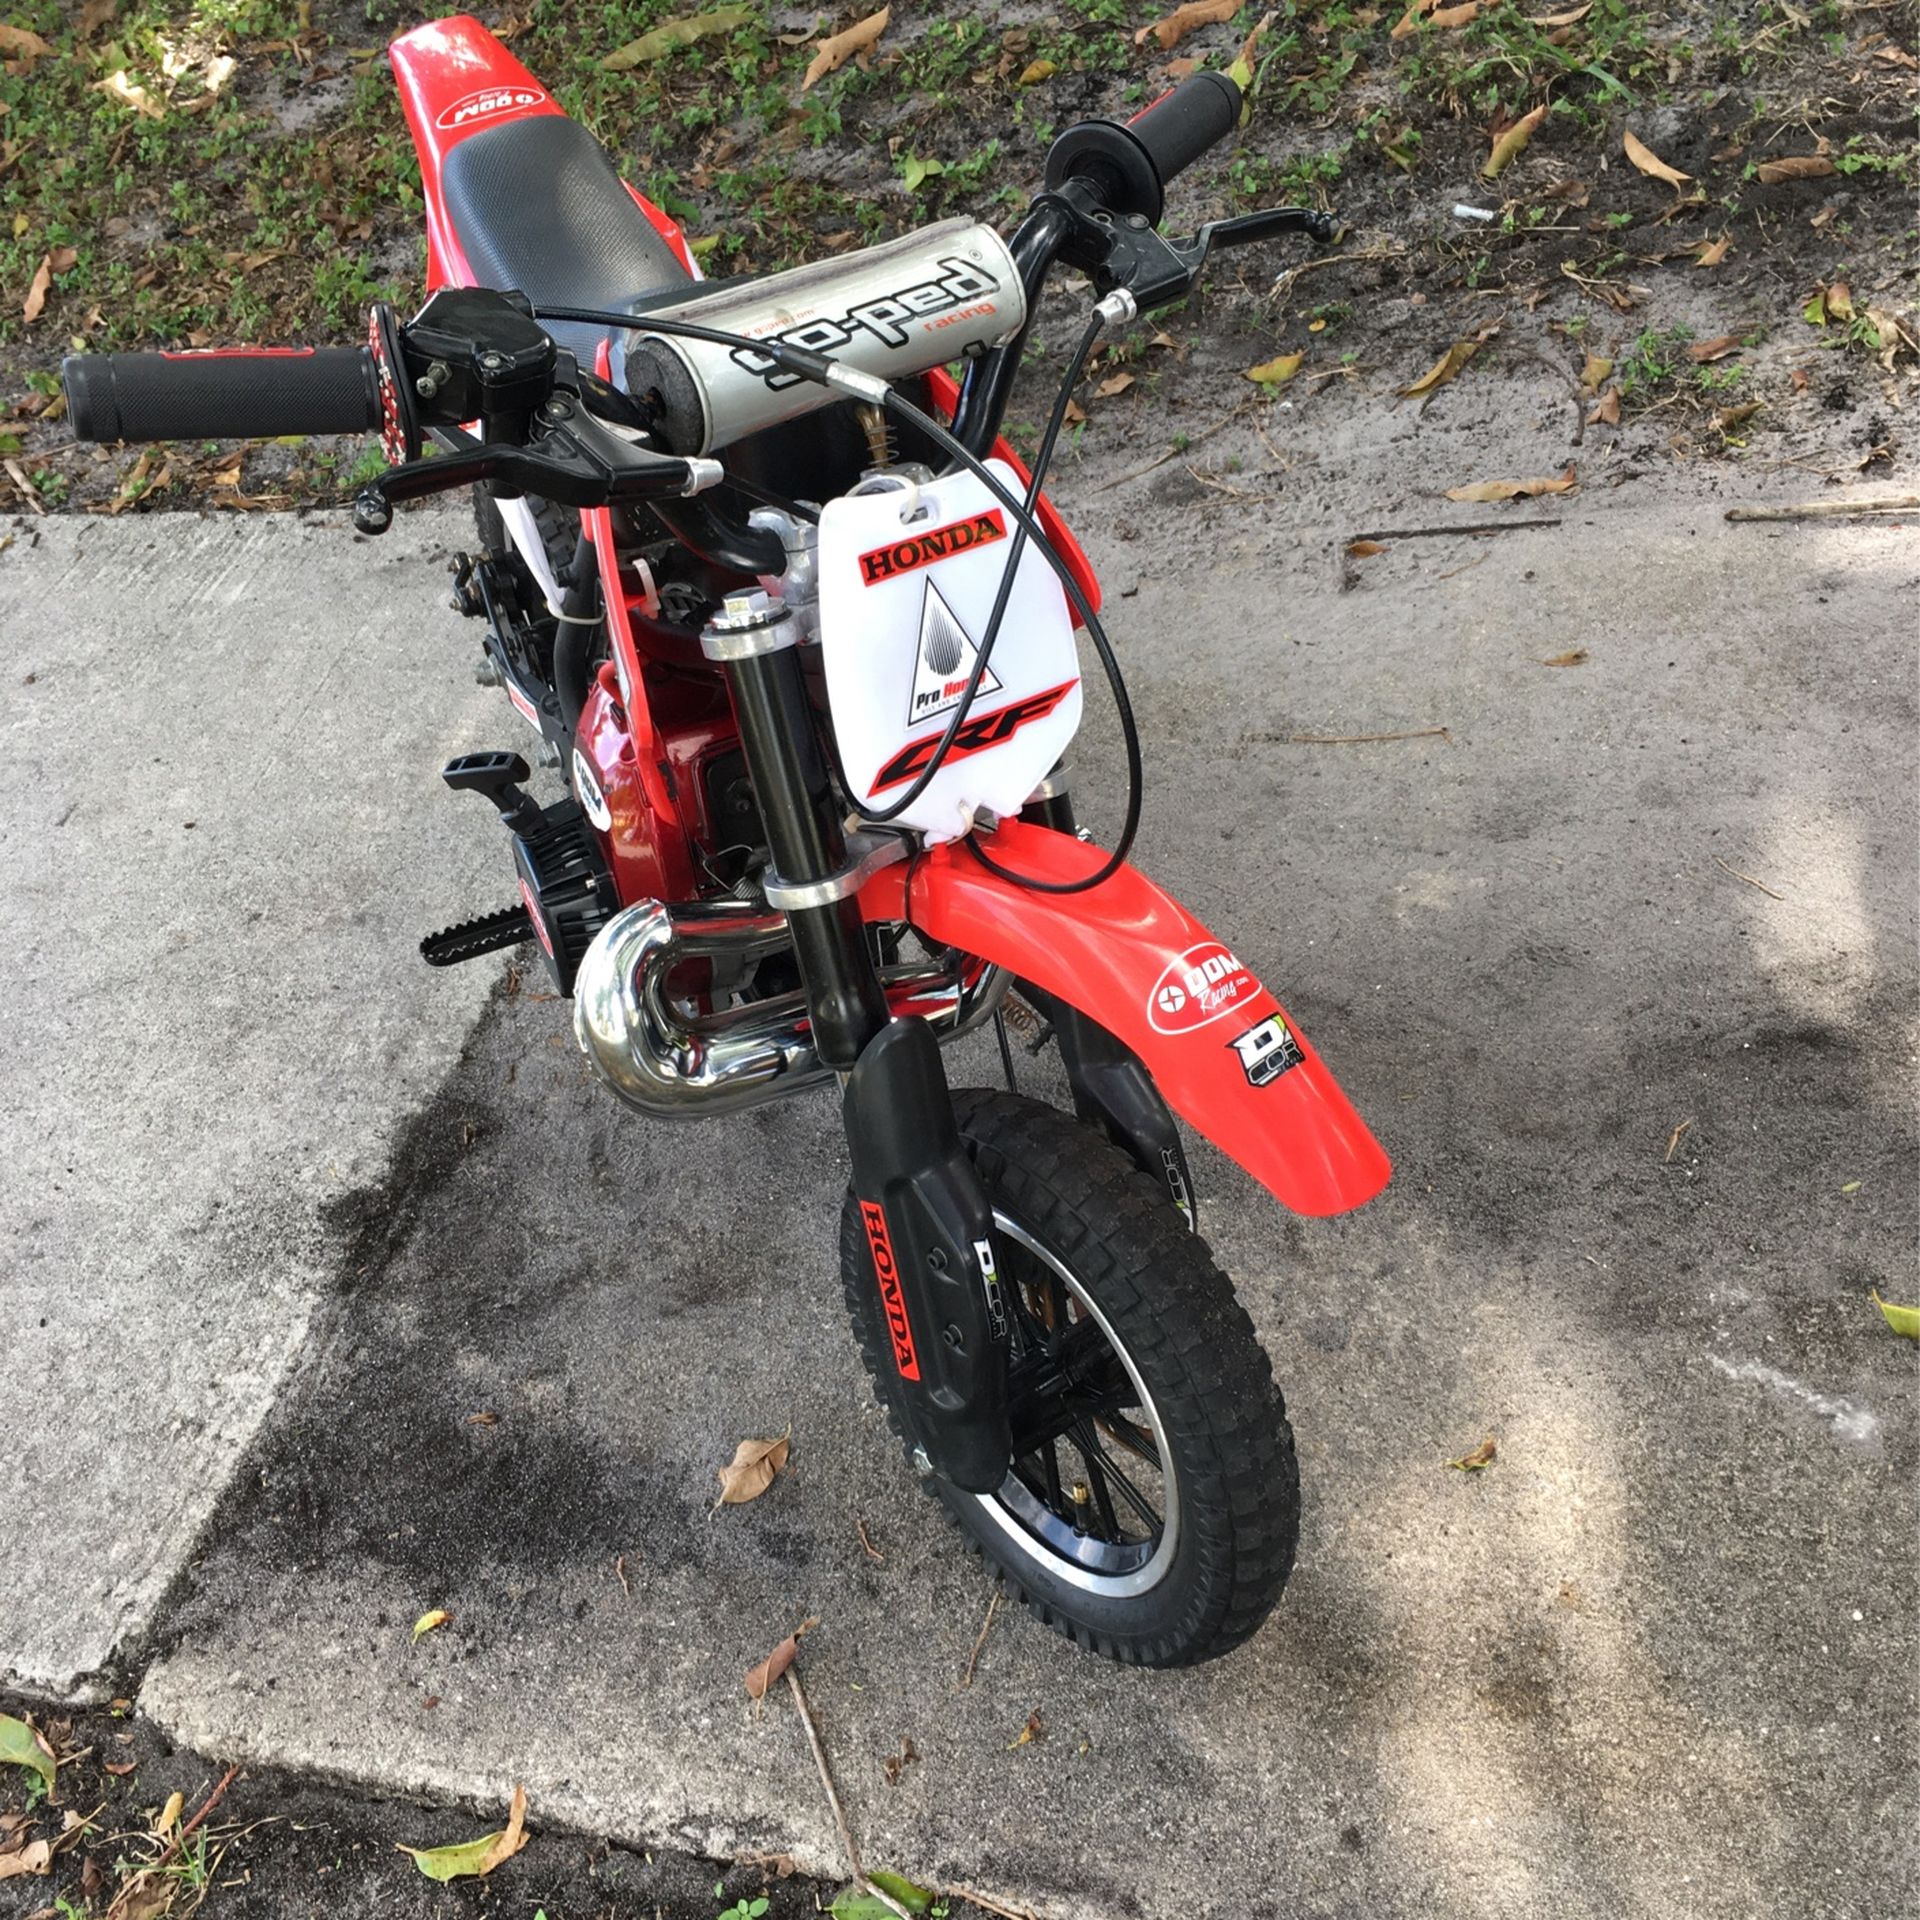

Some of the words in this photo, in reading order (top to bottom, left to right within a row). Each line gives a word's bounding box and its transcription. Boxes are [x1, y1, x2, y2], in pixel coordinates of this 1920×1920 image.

[924, 301, 997, 334] racing
[861, 514, 1001, 582] HONDA
[916, 689, 941, 710] Pro
[873, 690, 1066, 789] CRF
[1197, 980, 1238, 1016] Racing
[864, 1207, 915, 1370] HONDA
